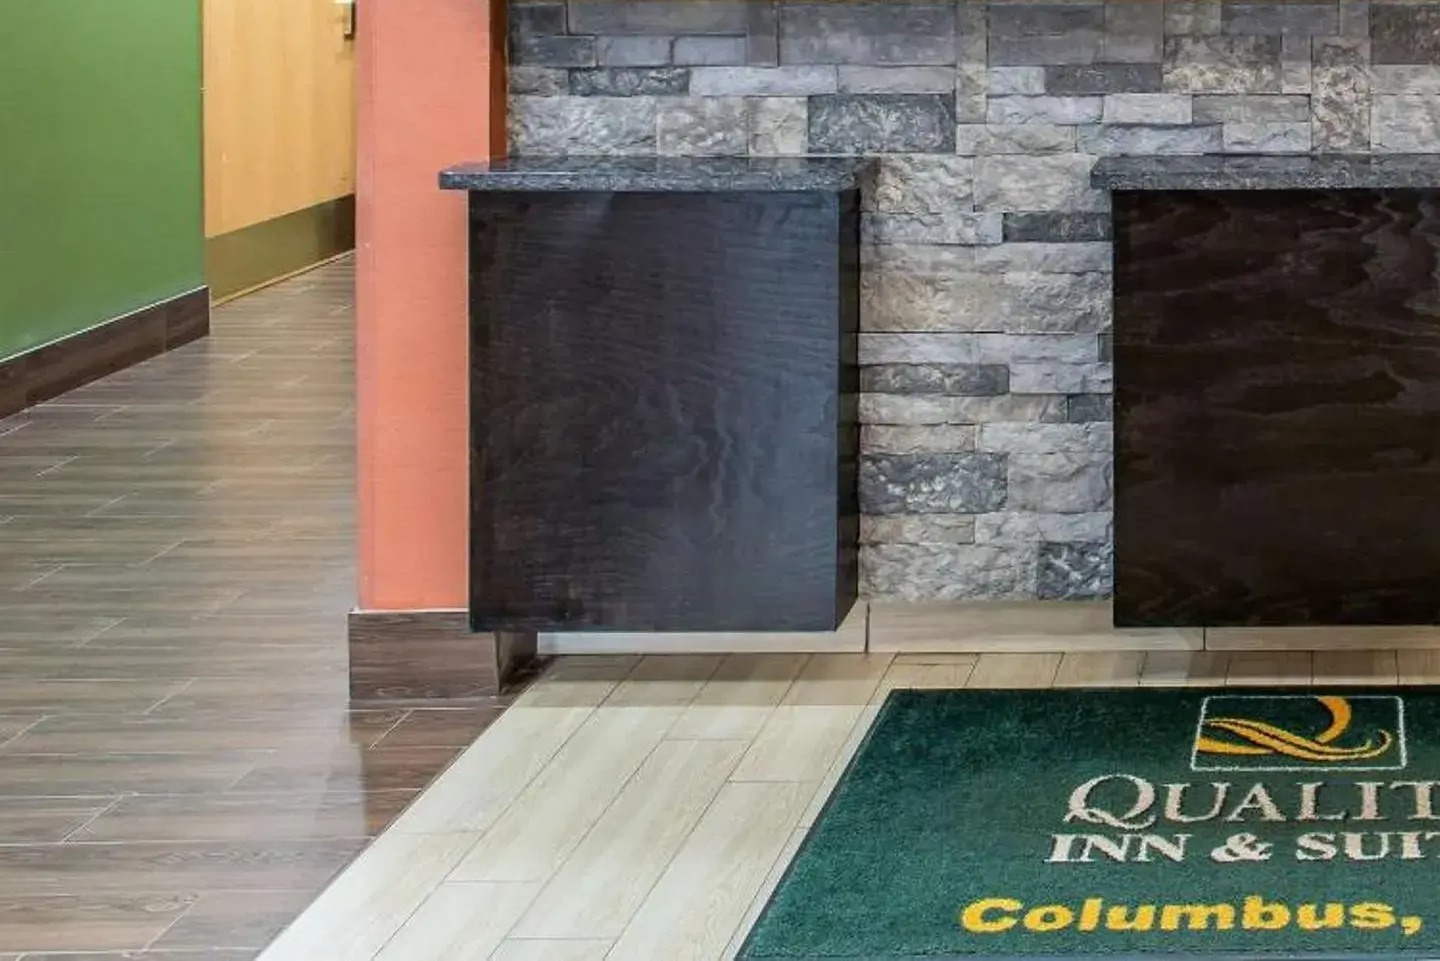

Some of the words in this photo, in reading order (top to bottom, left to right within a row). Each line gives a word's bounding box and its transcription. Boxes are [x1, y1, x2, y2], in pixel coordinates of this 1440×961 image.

[1044, 833, 1193, 863] INN
[1210, 833, 1273, 863] &
[961, 895, 1422, 936] Columbus,
